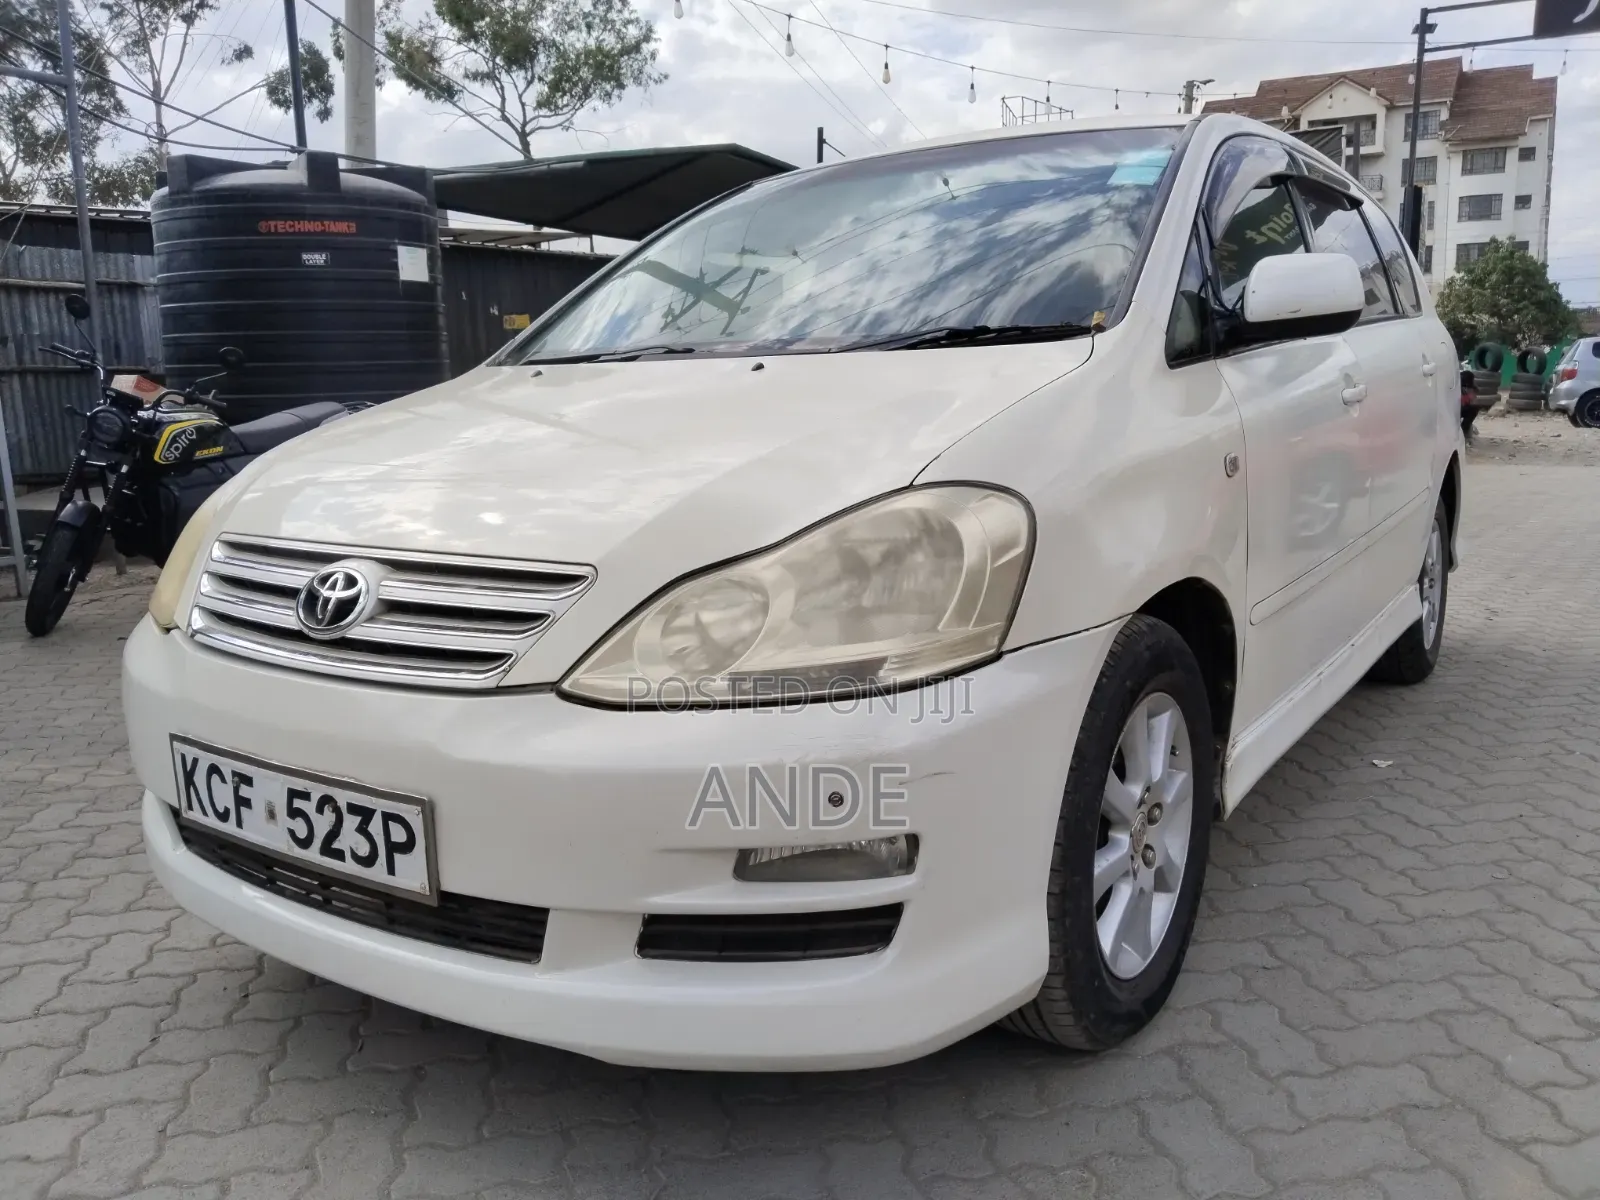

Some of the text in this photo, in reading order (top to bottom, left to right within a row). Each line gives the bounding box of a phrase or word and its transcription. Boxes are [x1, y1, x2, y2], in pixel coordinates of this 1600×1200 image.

[164, 427, 197, 462] spiro
[181, 753, 417, 877] KCF 523P
